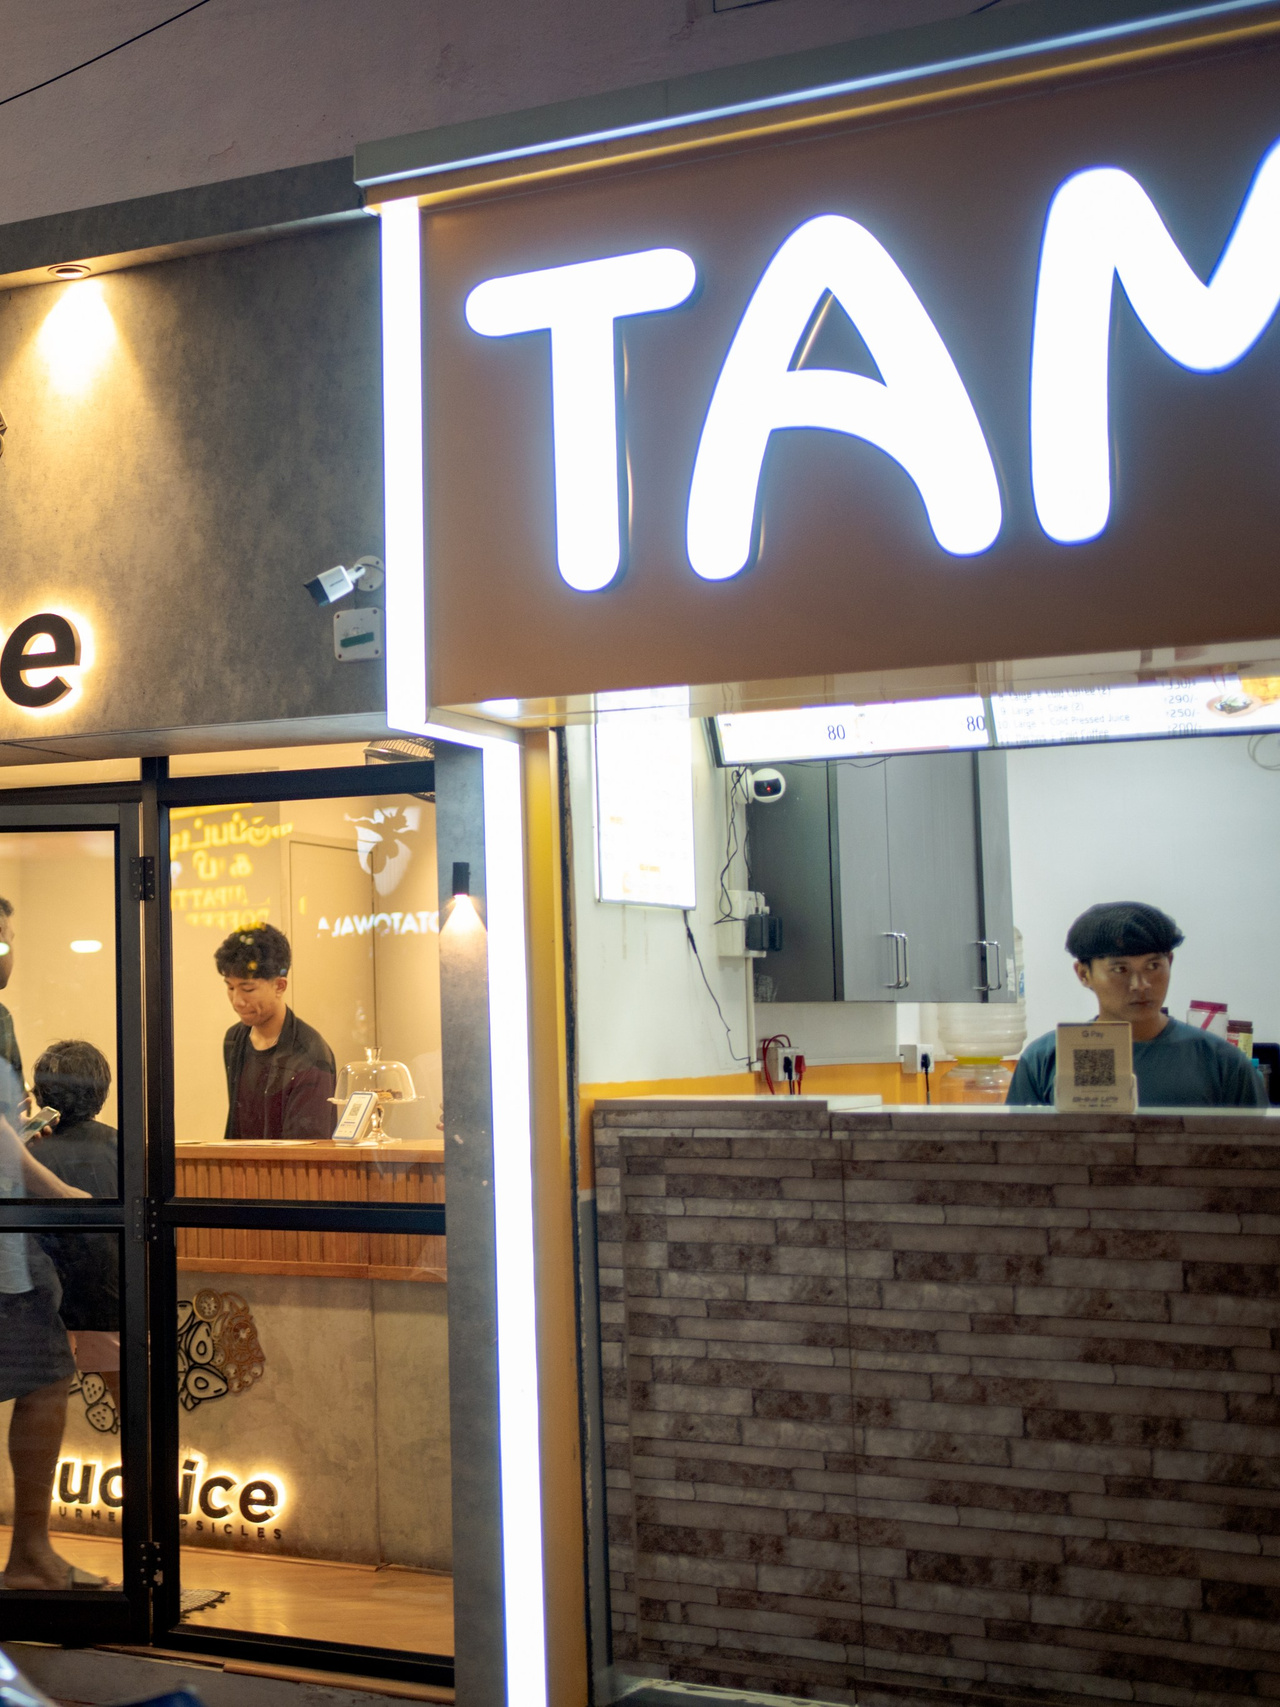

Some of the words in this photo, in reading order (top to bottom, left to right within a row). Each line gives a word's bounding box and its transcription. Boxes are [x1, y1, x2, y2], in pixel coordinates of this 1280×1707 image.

[827, 724, 846, 741] 80
[966, 714, 986, 732] 80
[54, 1458, 280, 1523] ucice
[58, 1505, 116, 1523] URME
[179, 1518, 284, 1541] PSICLES
